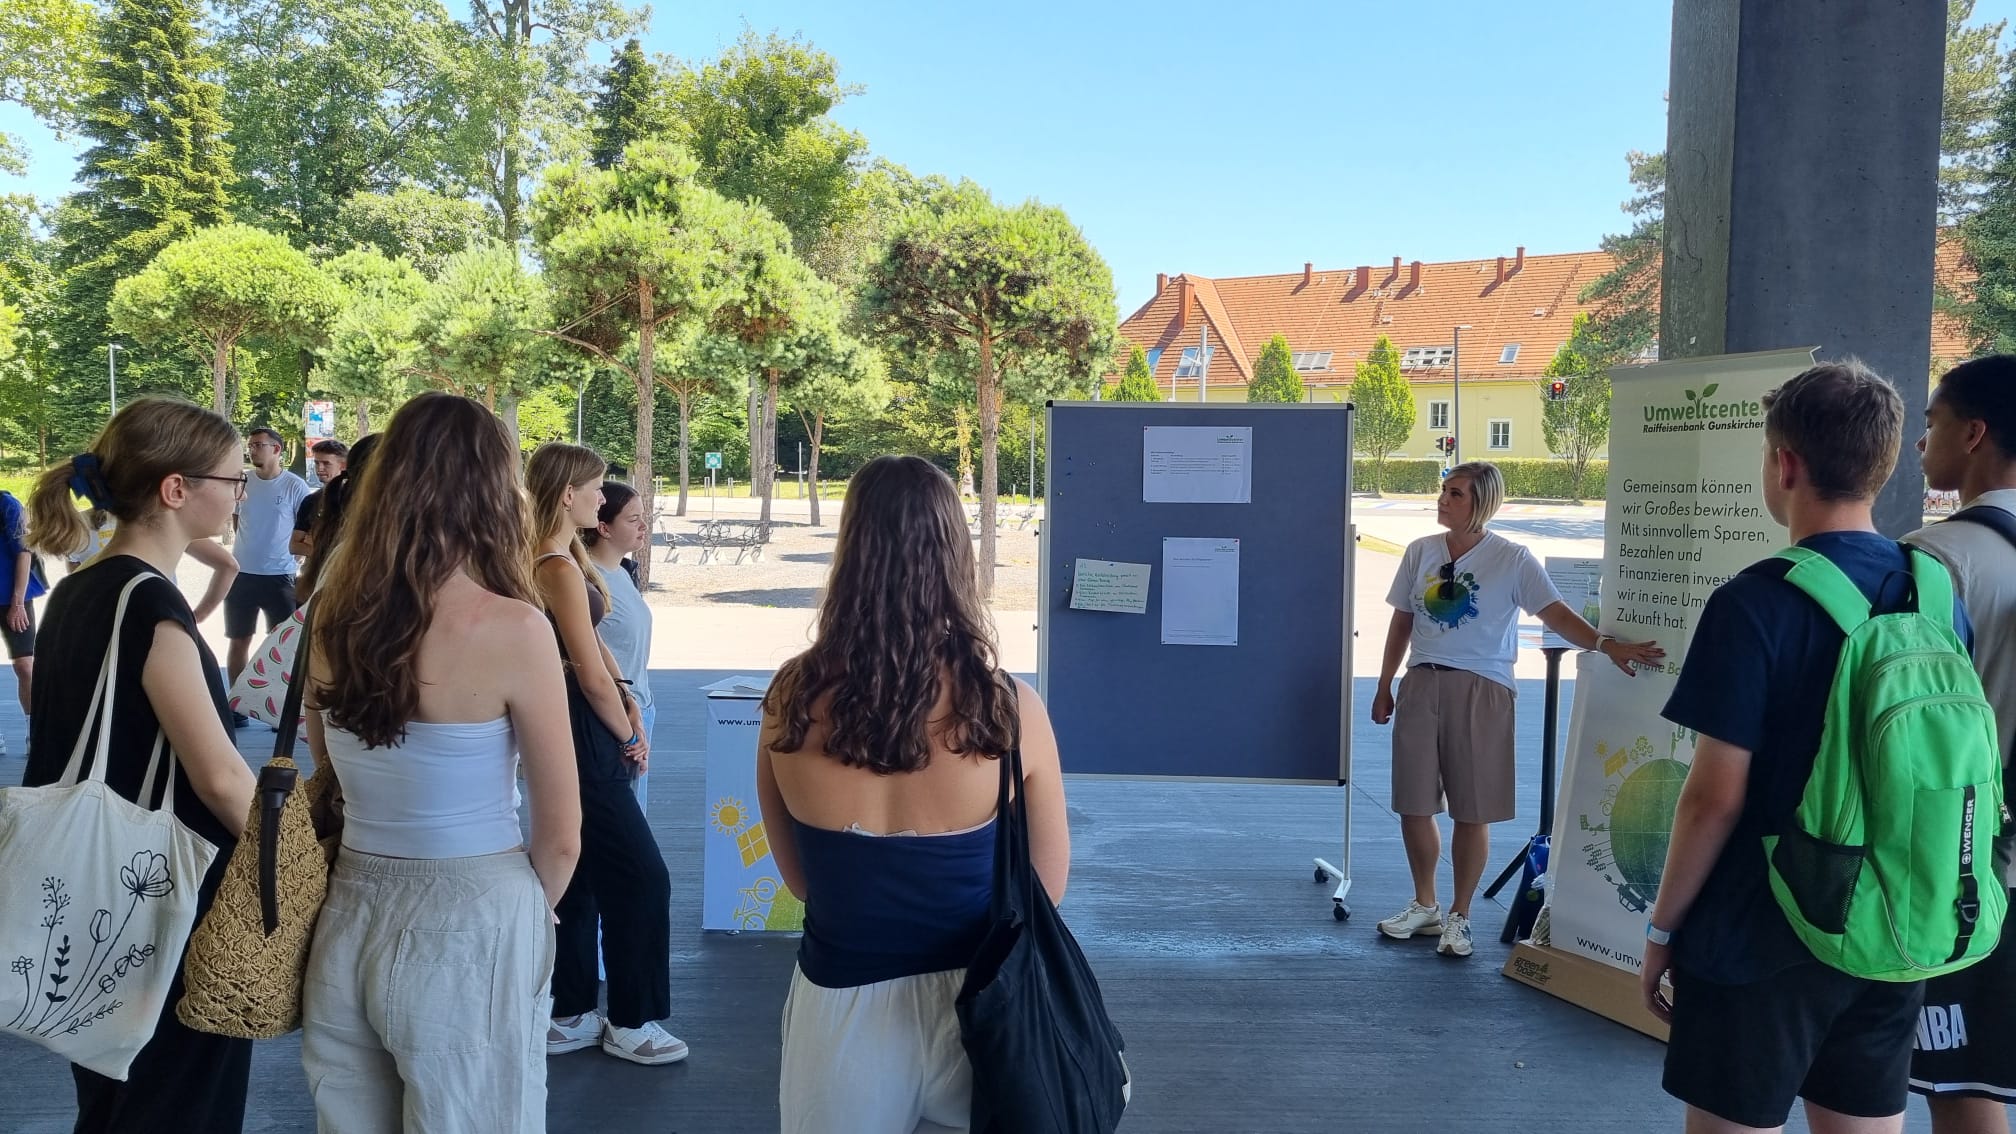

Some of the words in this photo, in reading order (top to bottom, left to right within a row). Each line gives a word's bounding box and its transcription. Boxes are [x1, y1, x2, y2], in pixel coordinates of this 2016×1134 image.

[1643, 399, 1763, 422] Umweltcente
[1643, 421, 1705, 434] Raiffeisenbank
[1623, 478, 1697, 494] Gemeinsam
[1701, 478, 1752, 494] können
[1622, 503, 1641, 515] wir
[1644, 501, 1690, 516] Großes
[1694, 501, 1763, 518] bewirken.
[1621, 522, 1639, 537] Mit
[1642, 523, 1710, 540] sinnvollem
[1713, 525, 1770, 544] Sparen,
[1619, 543, 1674, 560] Bezahlen
[1677, 547, 1702, 562] und
[1619, 565, 1689, 584] Finanzieren
[1693, 571, 1736, 587] inves
[1616, 588, 1636, 601] wir
[1638, 589, 1649, 603] in
[1651, 592, 1678, 606] eine
[1616, 607, 1660, 627] Zukunft
[1663, 612, 1687, 630] hat.
[1963, 799, 1974, 853] WENGER
[1912, 1003, 1969, 1051] NBA
